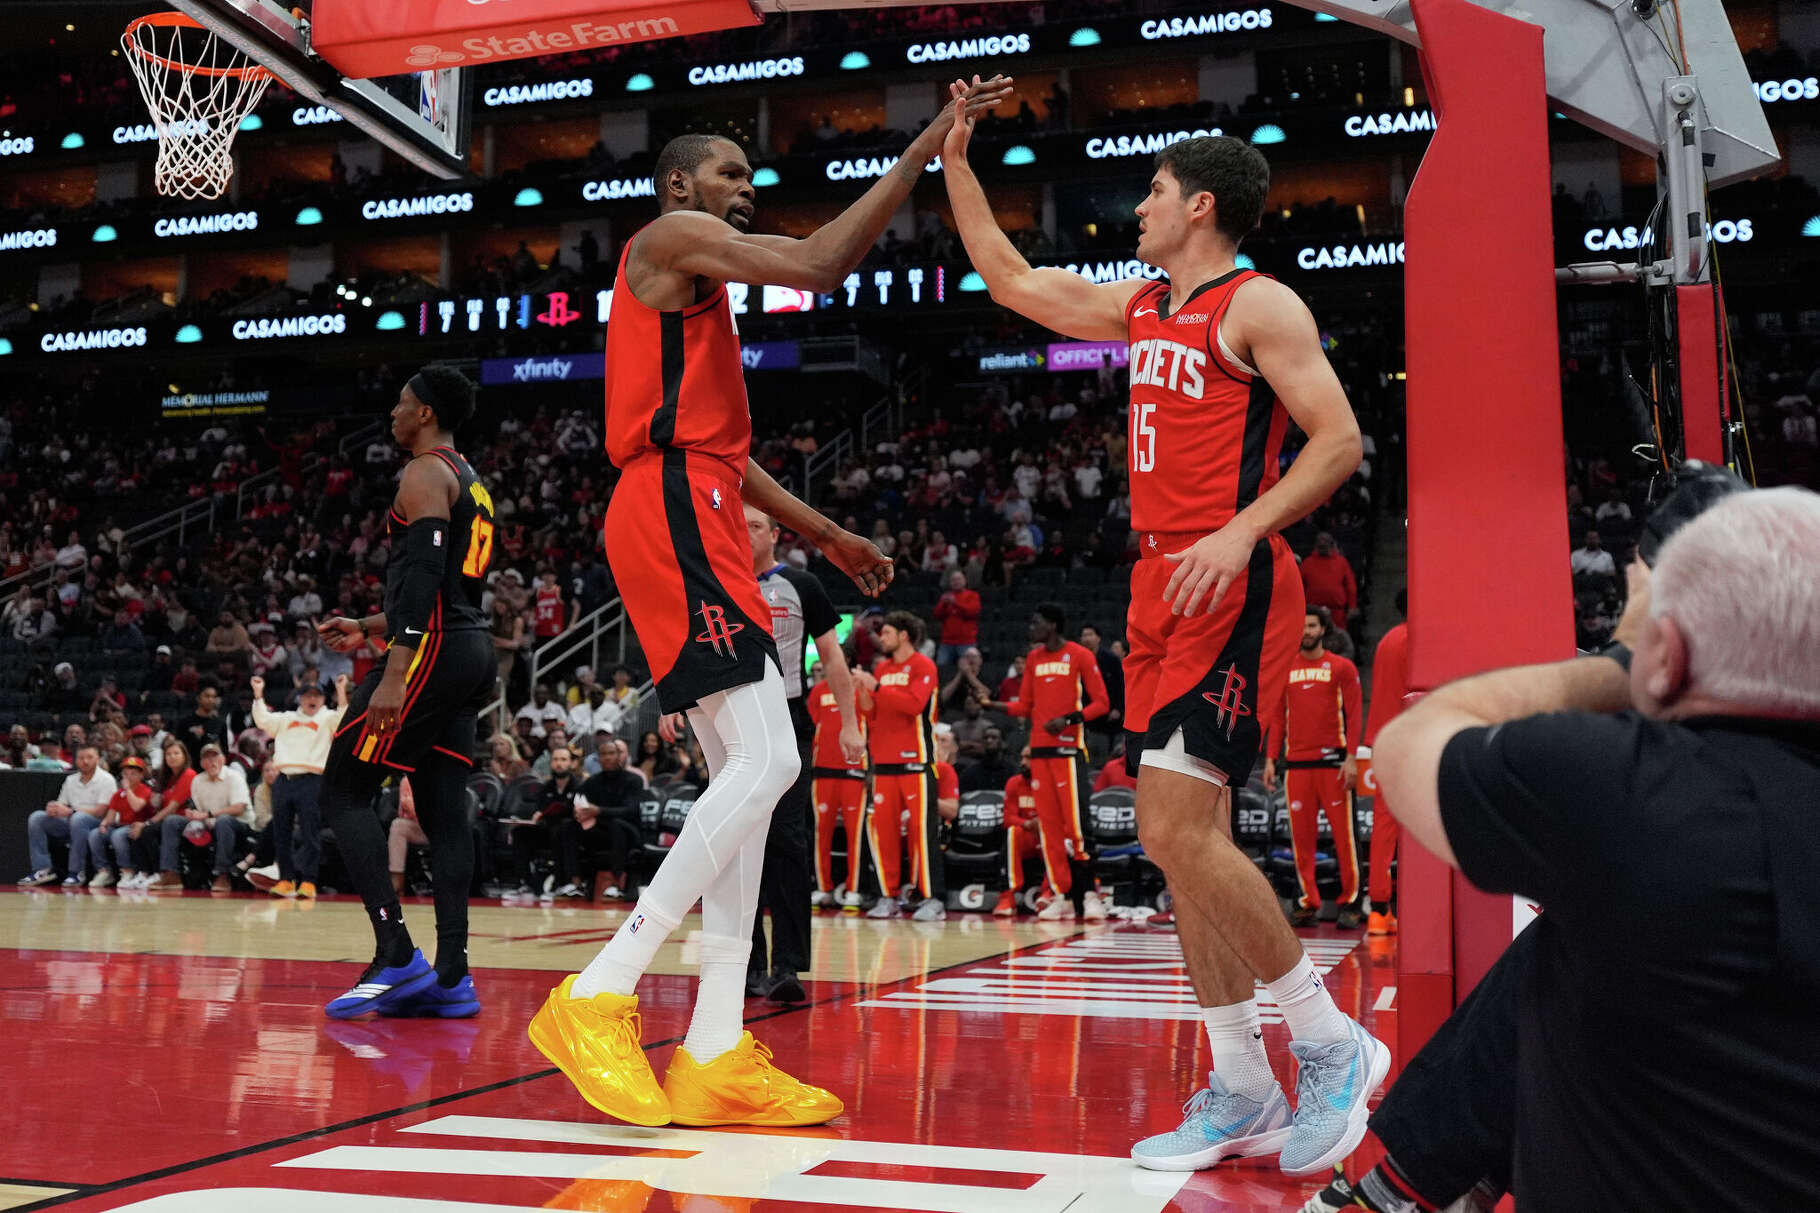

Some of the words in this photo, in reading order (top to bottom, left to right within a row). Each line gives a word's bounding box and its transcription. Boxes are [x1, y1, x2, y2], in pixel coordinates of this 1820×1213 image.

[1140, 9, 1273, 39] CASAMIGOS
[906, 34, 1031, 63] CASAMIGOS
[688, 57, 804, 85] CASAMIGOS
[483, 79, 594, 106] CASAMIGOS
[0, 137, 34, 155] GOS
[363, 193, 474, 219] CASAMIGOS
[154, 211, 258, 237] CASAMIGOS
[232, 314, 345, 339] CASAMIGOS
[41, 327, 147, 353] CASAMIGOS
[513, 357, 572, 381] xfinity
[979, 352, 1028, 370] reliant
[1133, 403, 1156, 472] 15
[462, 514, 494, 578] 17
